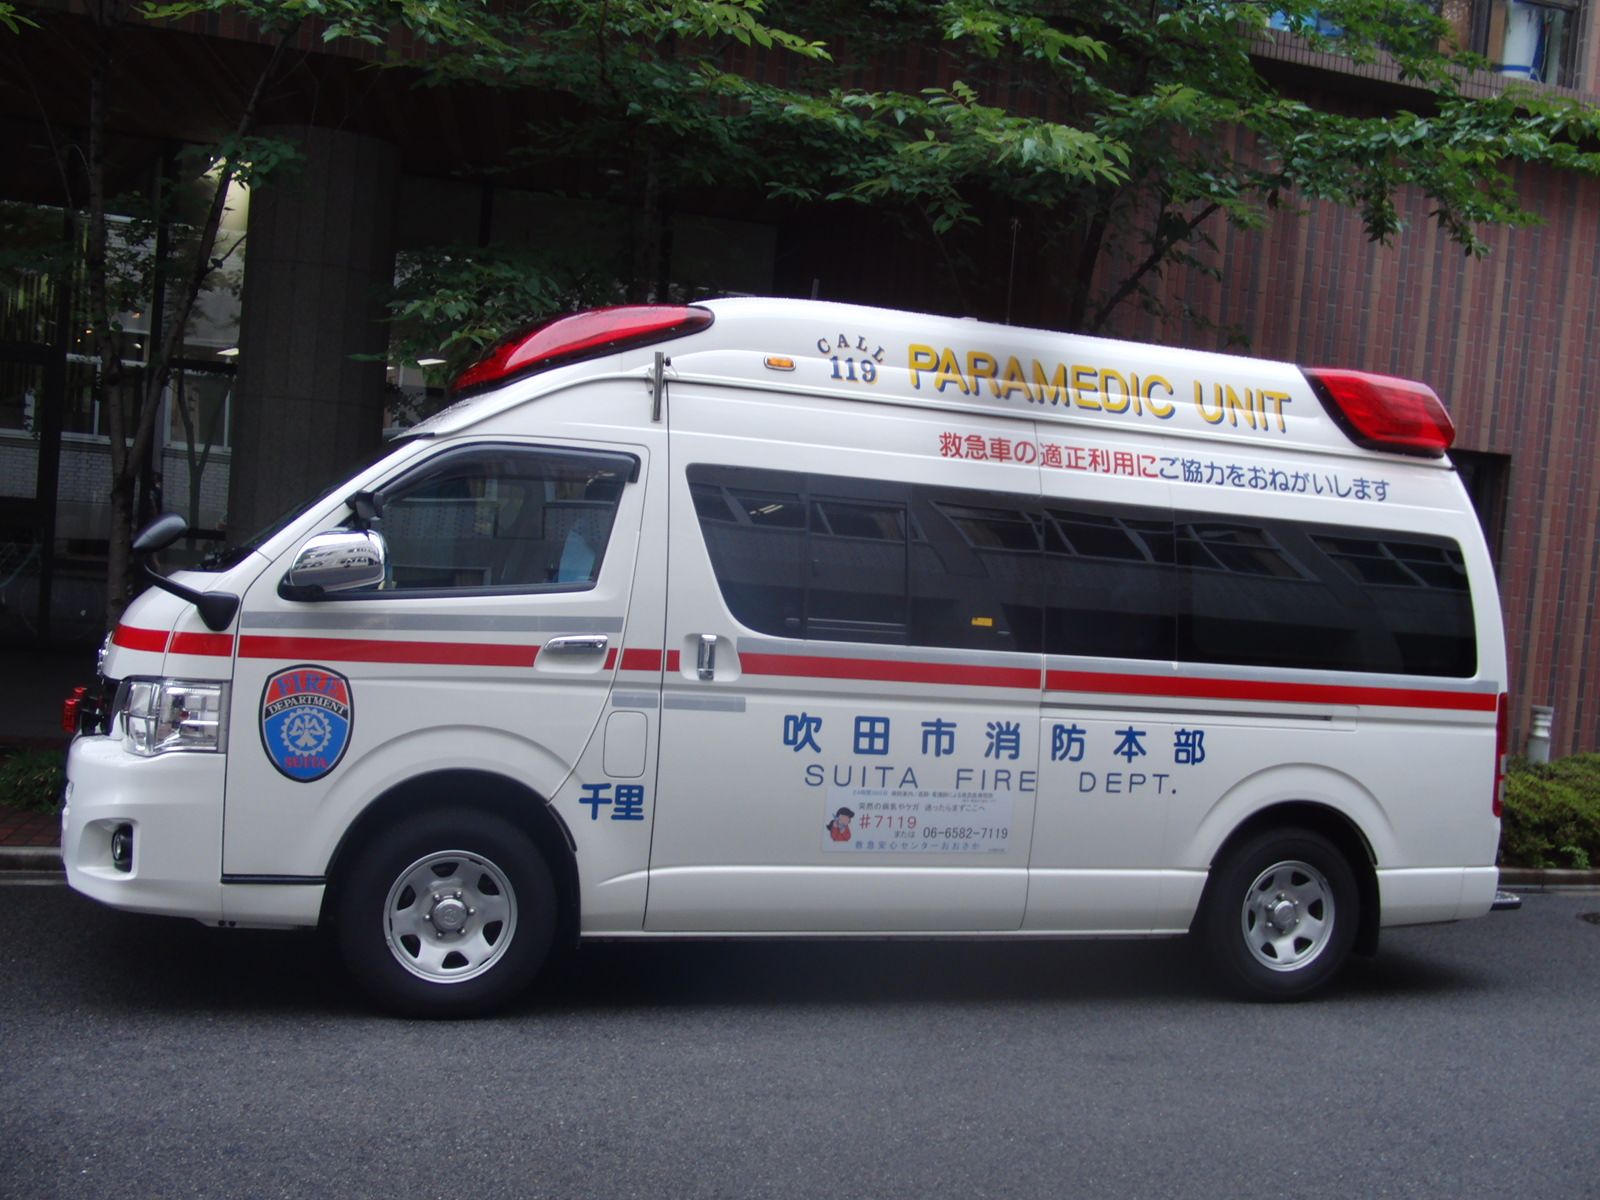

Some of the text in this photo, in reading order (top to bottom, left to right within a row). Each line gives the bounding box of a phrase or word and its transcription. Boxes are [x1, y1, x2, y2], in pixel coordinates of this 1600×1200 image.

[816, 333, 886, 364] CALL
[830, 355, 878, 384] 119
[908, 343, 1292, 434] PARAMEDIC UNIT
[938, 431, 1390, 502] 救急車の適正利用にご協力をおねがいします
[277, 672, 339, 698] FIRE
[267, 695, 346, 716] DEPARTMENT
[783, 712, 1206, 766] 吹田市消防本部
[284, 755, 329, 769] SUITA
[804, 764, 1177, 795] SUITA FIRE DEPT.
[578, 782, 645, 821] 千里
[858, 814, 918, 830] #7119
[922, 826, 1009, 841] 06-6582-7119
